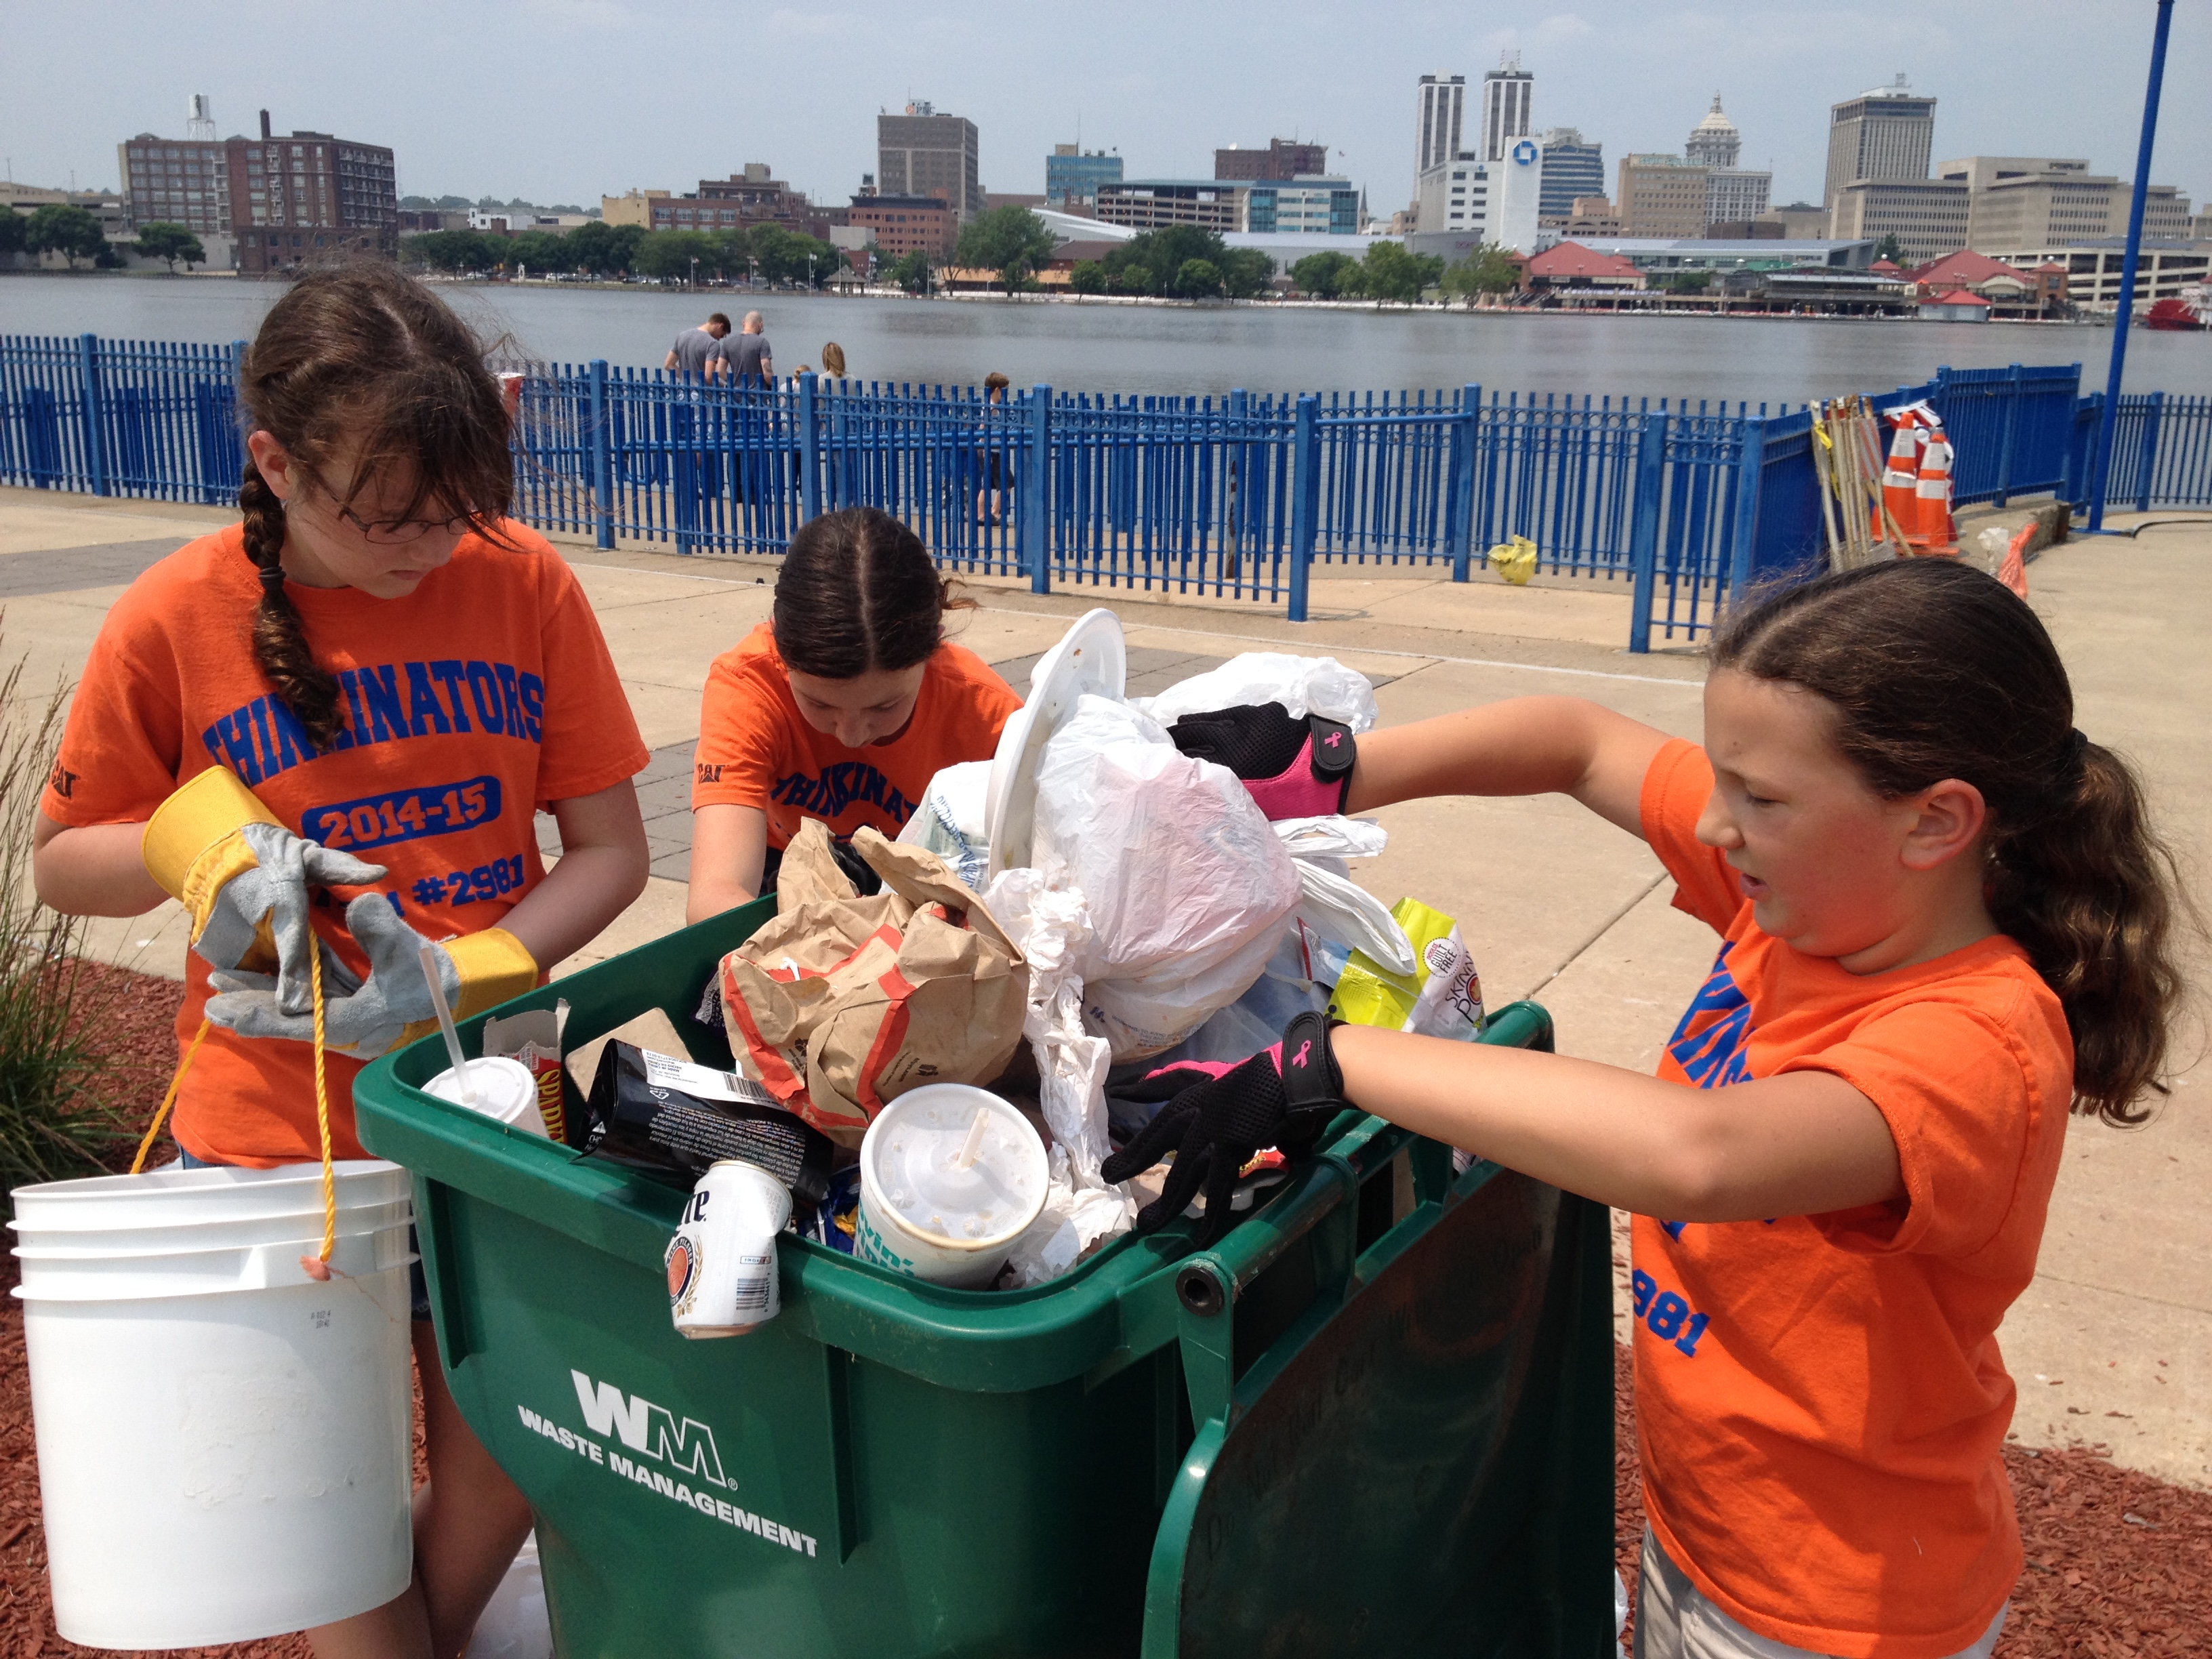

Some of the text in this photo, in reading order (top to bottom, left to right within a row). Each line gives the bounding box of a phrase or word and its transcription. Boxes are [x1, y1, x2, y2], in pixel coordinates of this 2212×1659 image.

[203, 659, 544, 787] THININATORS
[697, 763, 726, 785] CAT
[319, 782, 487, 849] 2014-15
[411, 854, 525, 908] #2981
[1431, 943, 1448, 968] GUILT
[1439, 949, 1457, 974] FREE
[539, 1069, 565, 1145] SPARK
[679, 1238, 693, 1265] PILSNER
[1633, 1269, 1711, 1358] 981
[518, 1405, 817, 1558] WASTE MANAGEMENT
